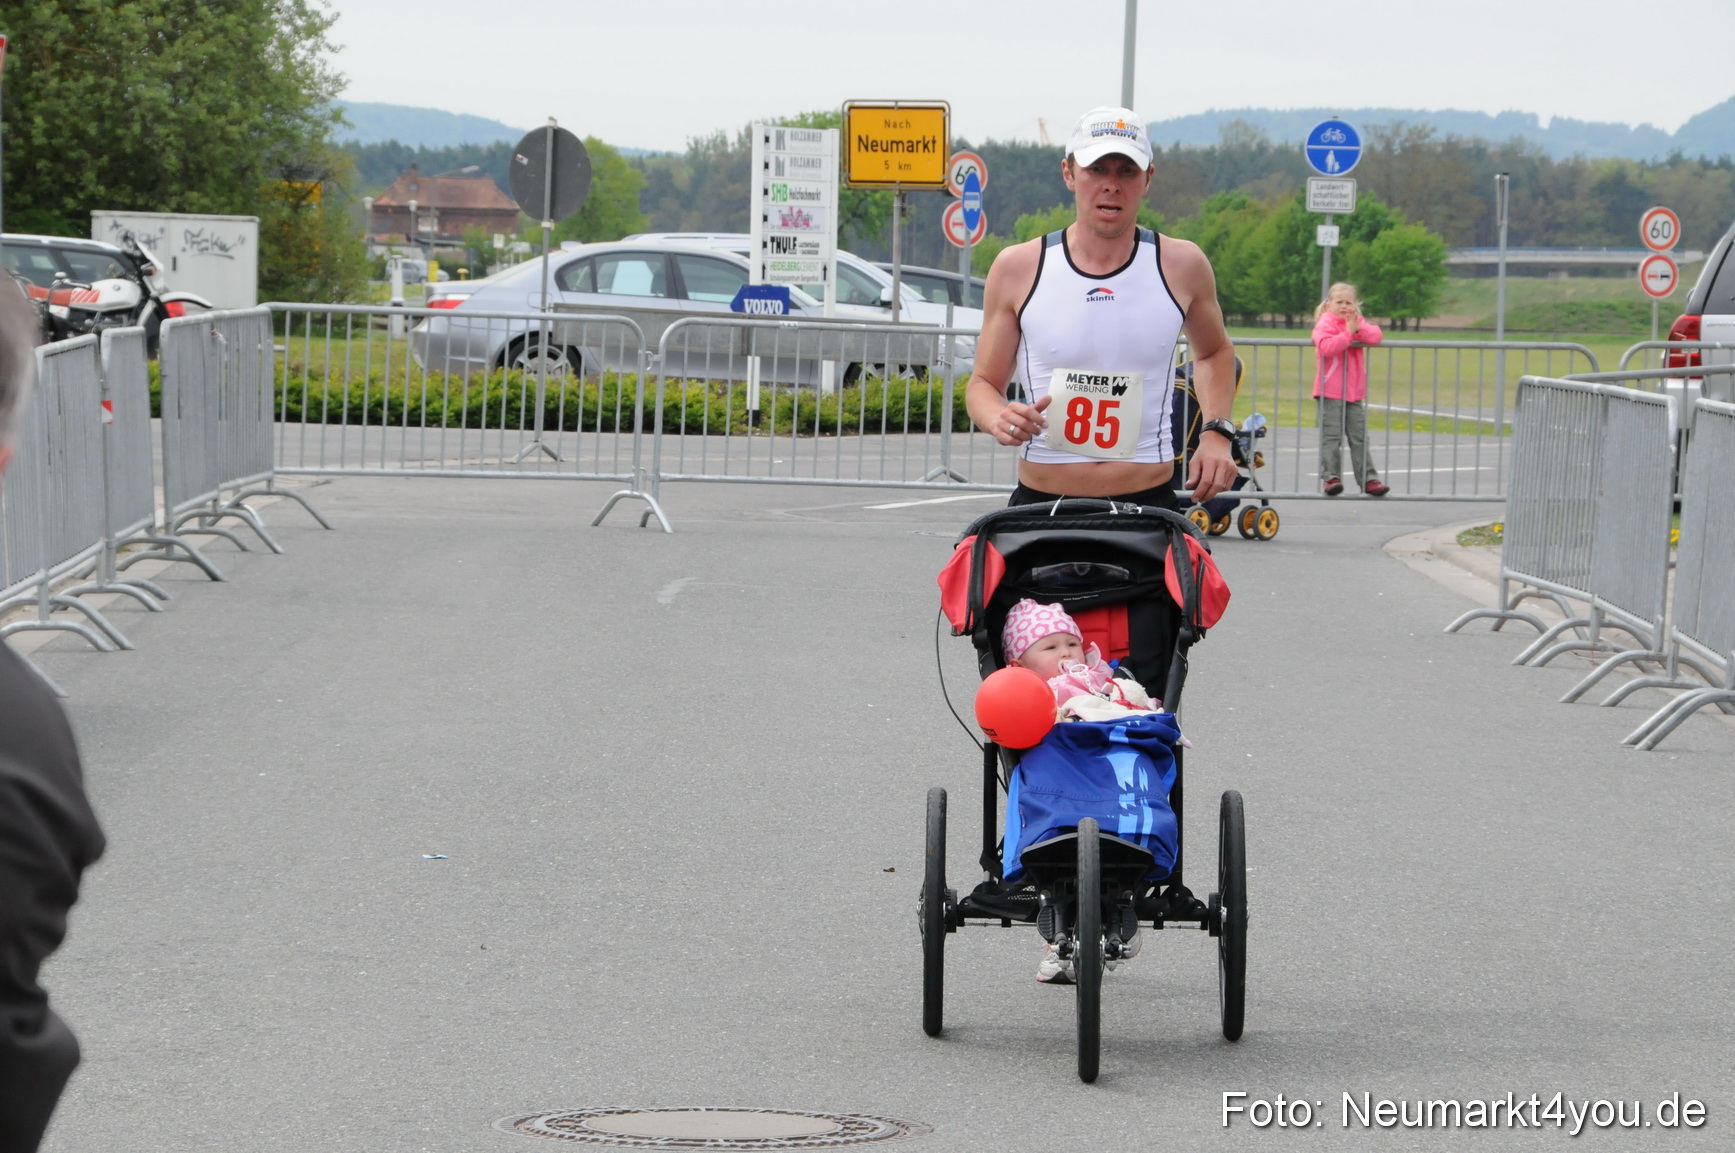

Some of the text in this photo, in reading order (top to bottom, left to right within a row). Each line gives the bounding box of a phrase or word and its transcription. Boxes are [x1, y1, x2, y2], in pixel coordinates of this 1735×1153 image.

[884, 119, 911, 129] Nach
[857, 134, 937, 153] Neumarkt
[884, 160, 912, 171] 5 km
[1650, 220, 1672, 239] 60
[1086, 295, 1115, 303] skinfit
[743, 298, 784, 316] VOLVO
[1066, 373, 1109, 386] MEYER
[1065, 383, 1109, 394] WERBUNG
[1064, 396, 1120, 449] 85
